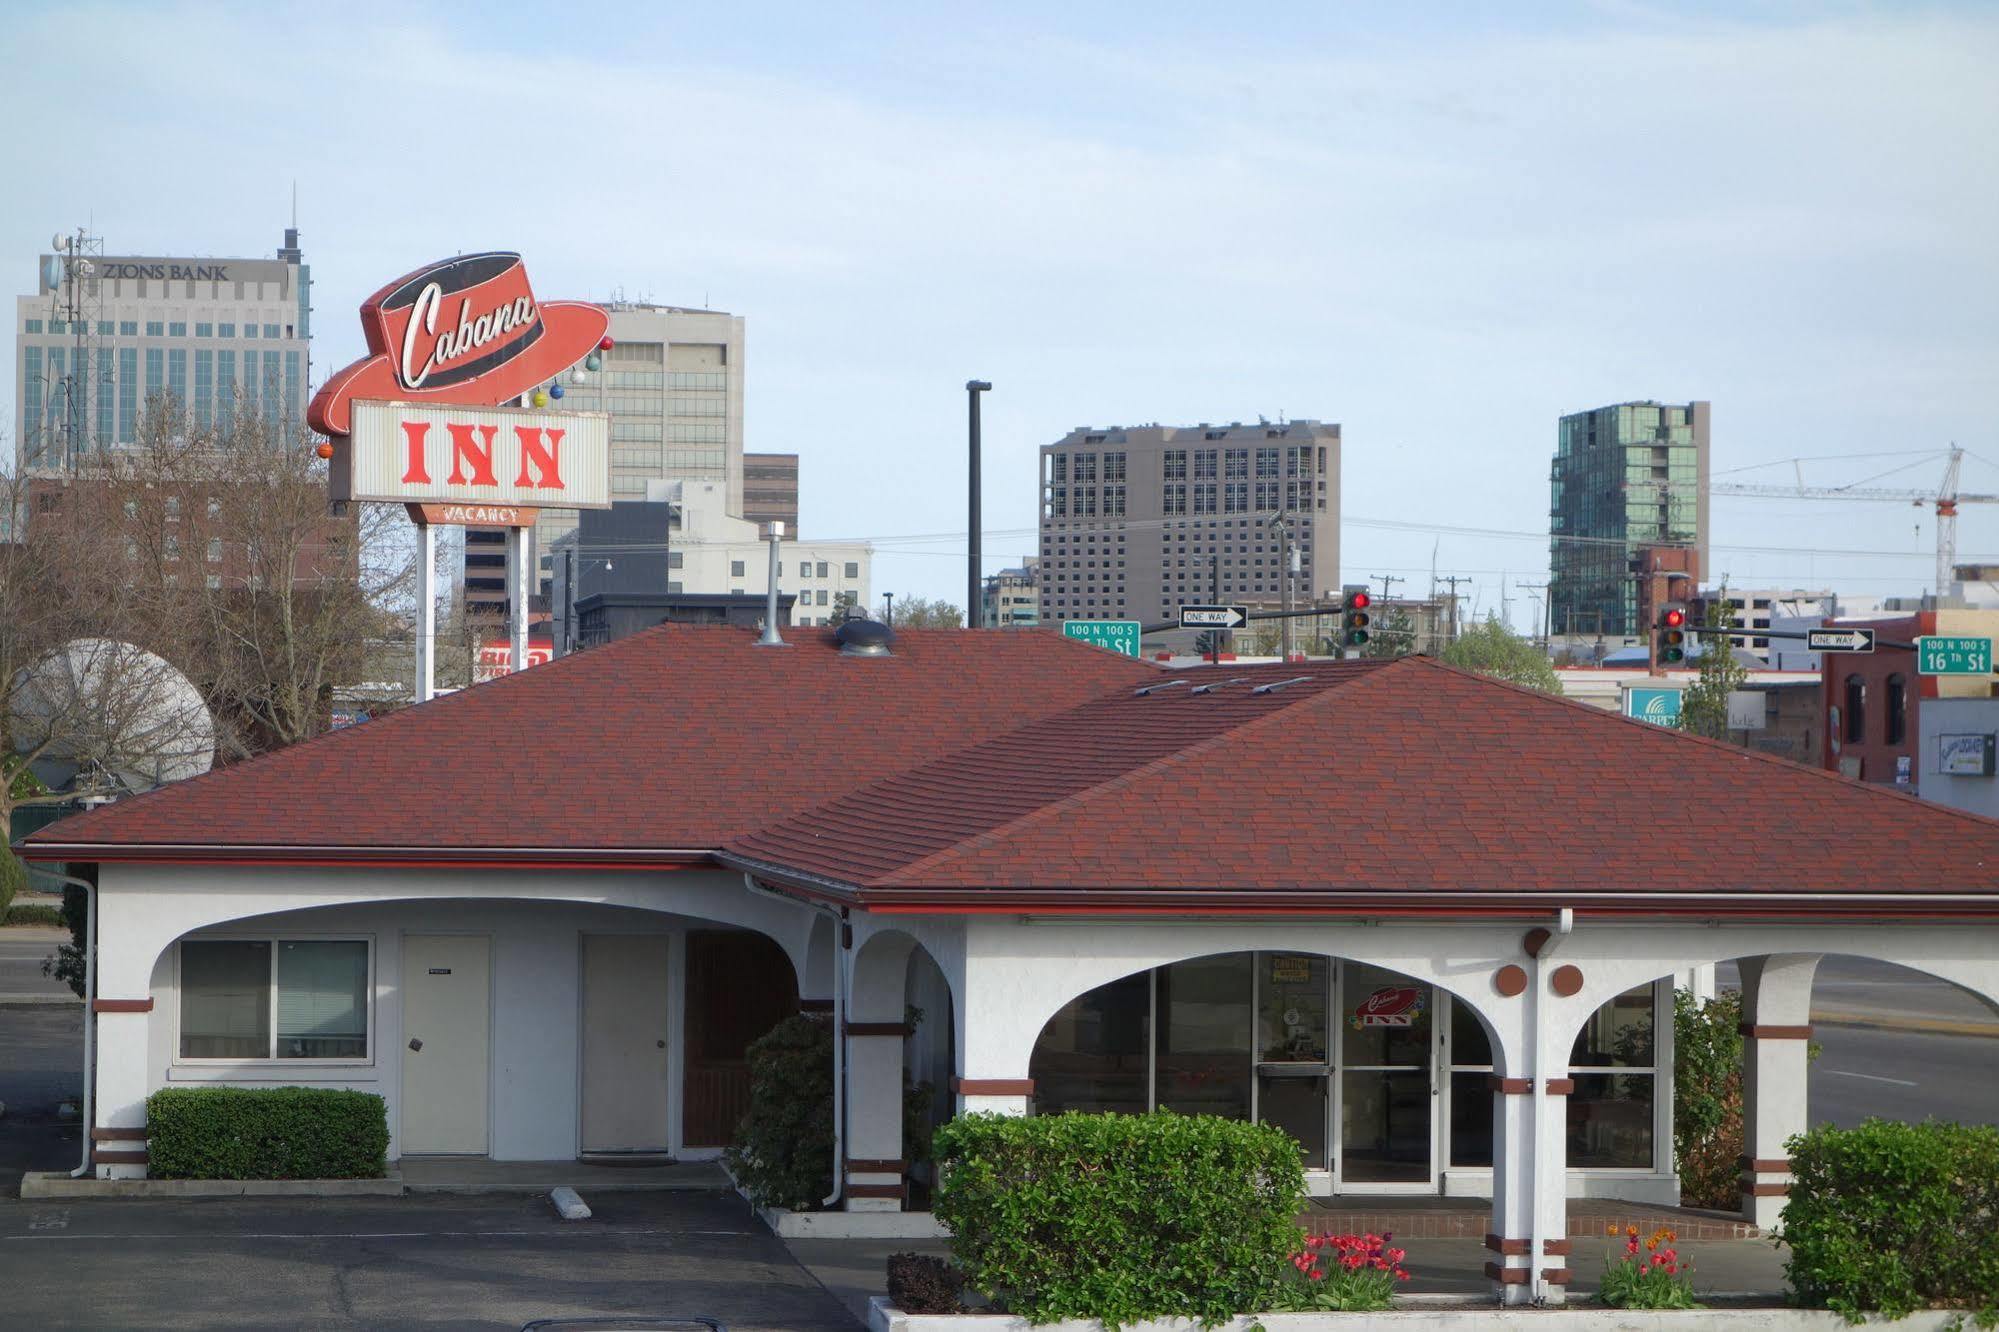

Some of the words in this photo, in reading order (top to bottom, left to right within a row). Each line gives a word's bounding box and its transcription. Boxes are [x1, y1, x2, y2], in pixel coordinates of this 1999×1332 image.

[103, 263, 165, 280] ZIONS
[169, 264, 229, 281] BANK
[402, 282, 535, 388] Cabana
[401, 420, 566, 490] INN
[442, 505, 520, 523] VACANCY
[1186, 612, 1205, 622] ONE
[1208, 612, 1228, 622] WAY
[1071, 625, 1089, 635] 100
[1093, 625, 1100, 635] N
[1106, 625, 1124, 635] 100
[1127, 625, 1133, 636] S
[1813, 634, 1832, 645] ONE
[1836, 634, 1854, 645] WAY
[1926, 640, 1944, 650] 100
[1947, 640, 1954, 650] N
[1960, 639, 1977, 650] 100
[1980, 639, 1986, 650] S
[1927, 654, 1946, 670] 16
[1967, 653, 1985, 671] St
[1366, 1016, 1408, 1025] INN
